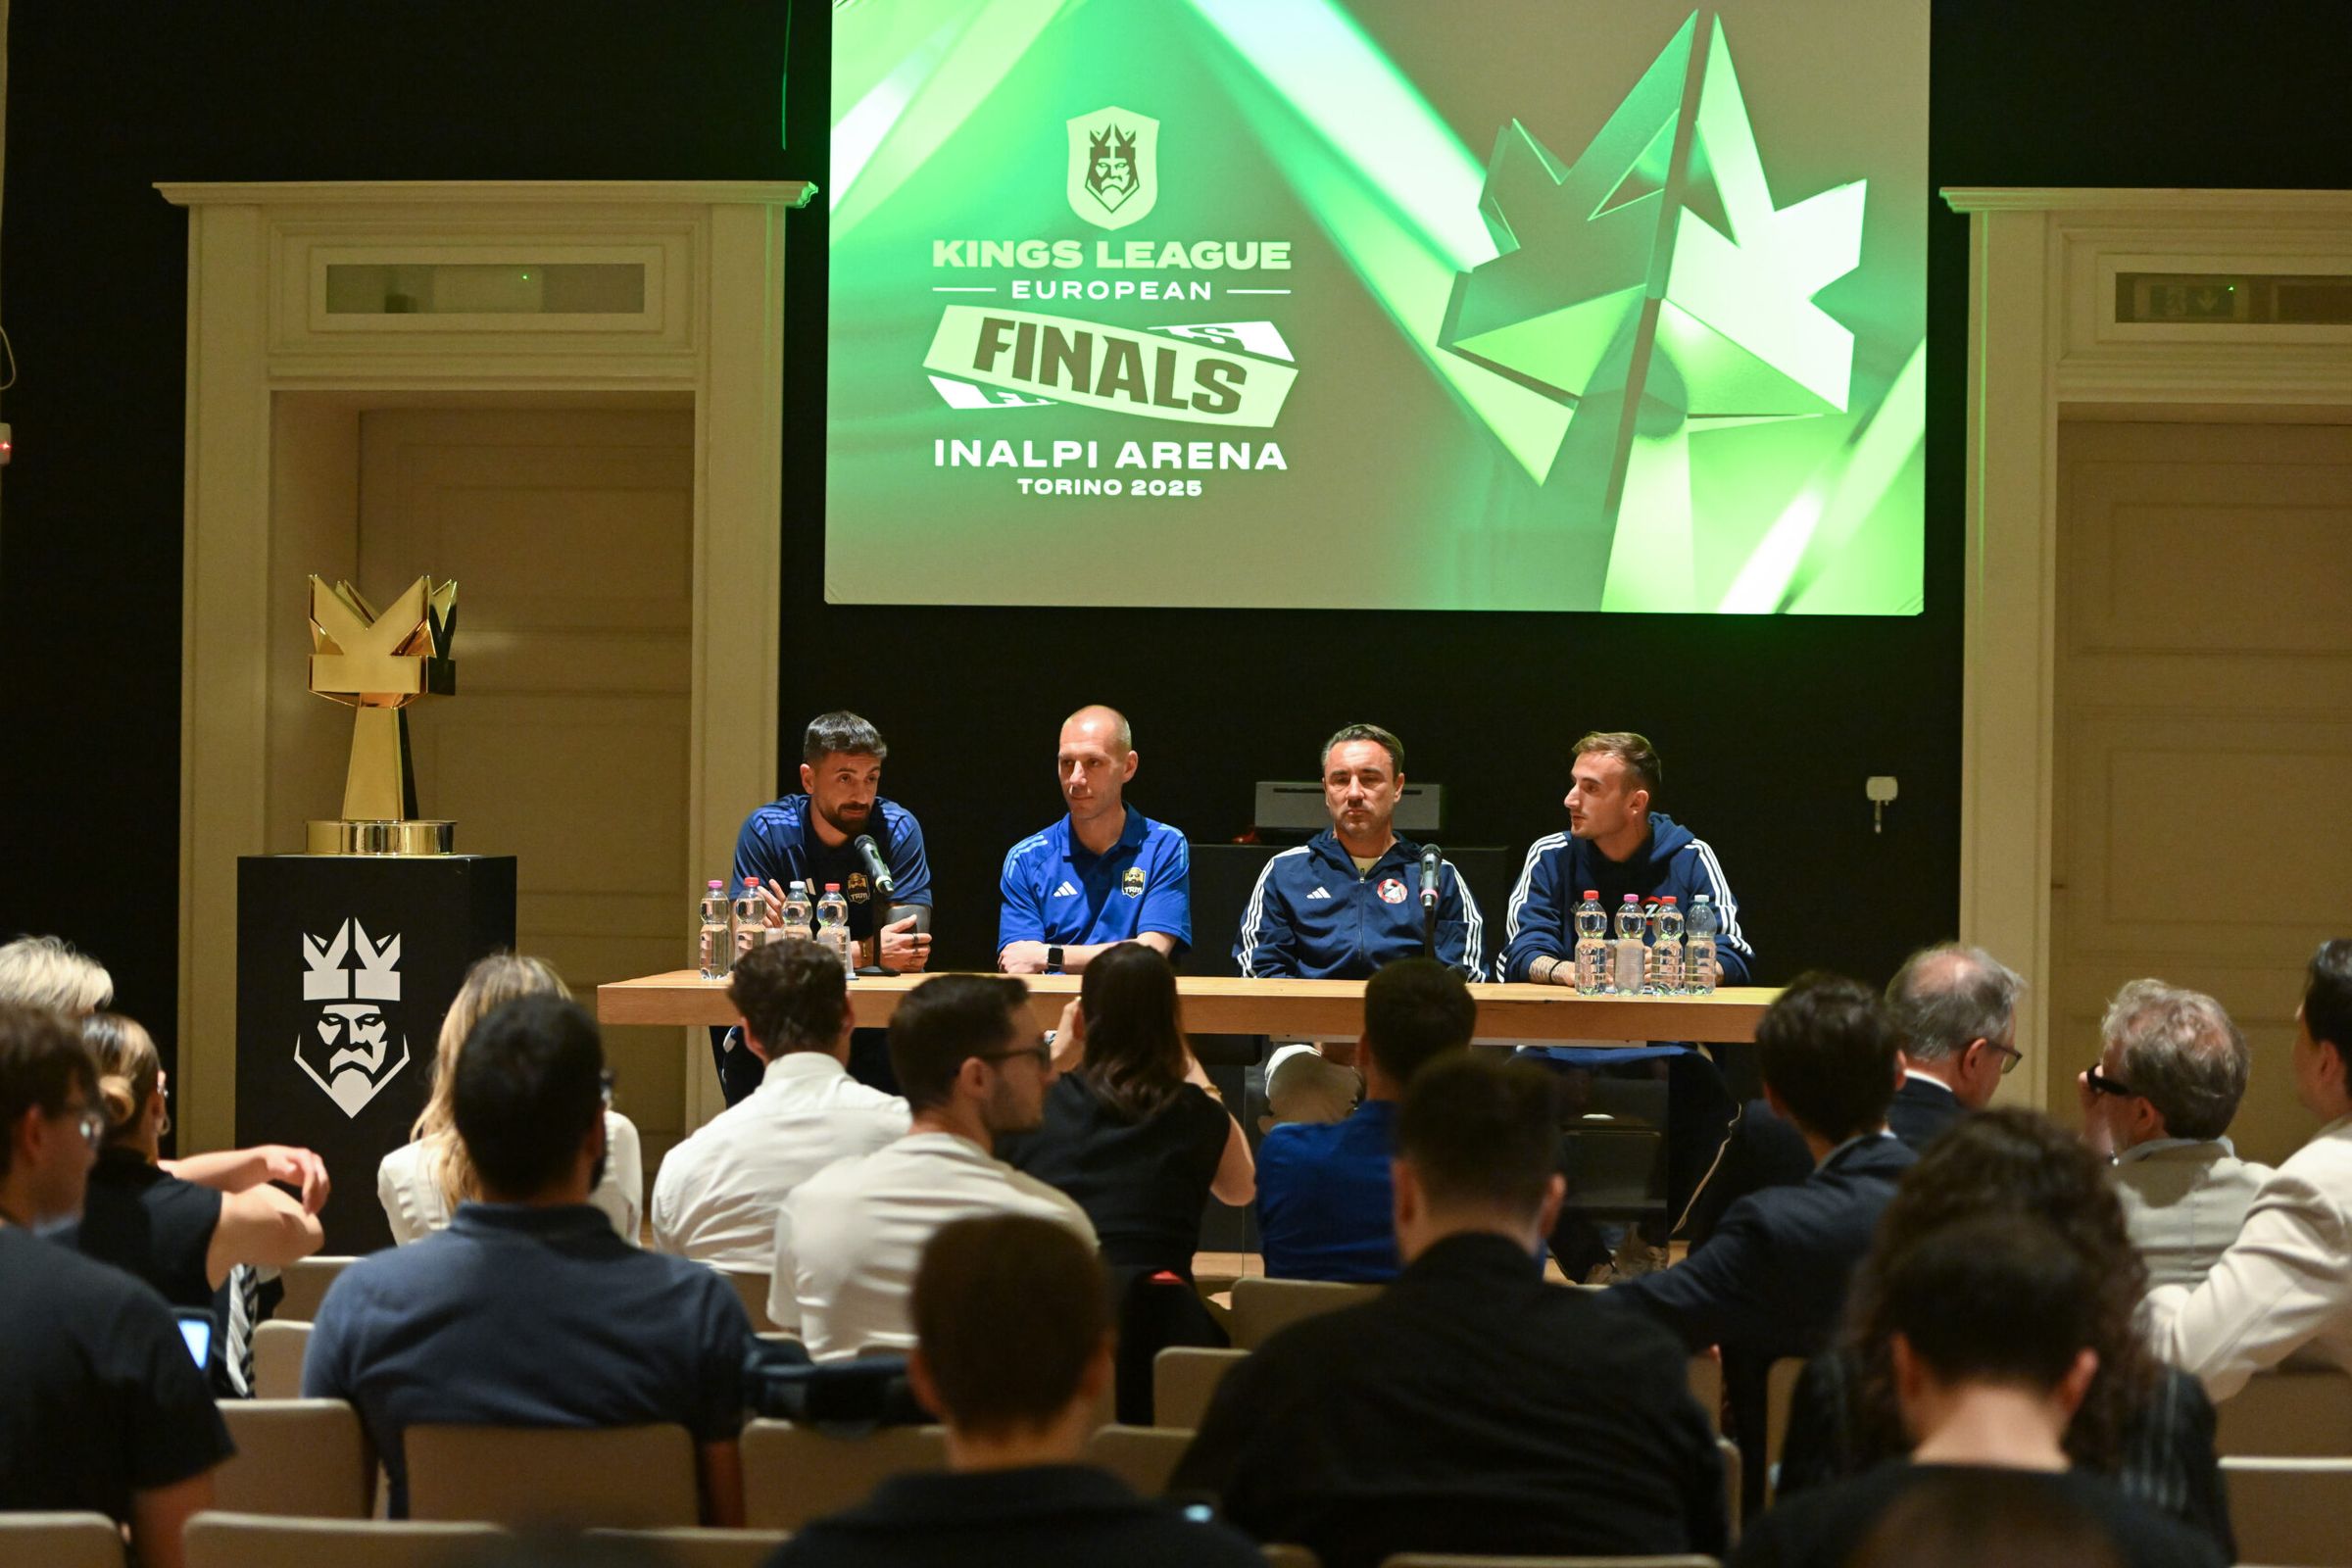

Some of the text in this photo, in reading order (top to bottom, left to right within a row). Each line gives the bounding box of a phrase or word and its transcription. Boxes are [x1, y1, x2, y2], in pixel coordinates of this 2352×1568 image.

[933, 239, 1292, 270] KINGS LEAGUE
[1011, 280, 1211, 301] EUROPEAN
[972, 316, 1248, 416] FINALS
[934, 439, 1288, 470] INALPI ARENA
[1017, 478, 1202, 497] TORINO 2025
